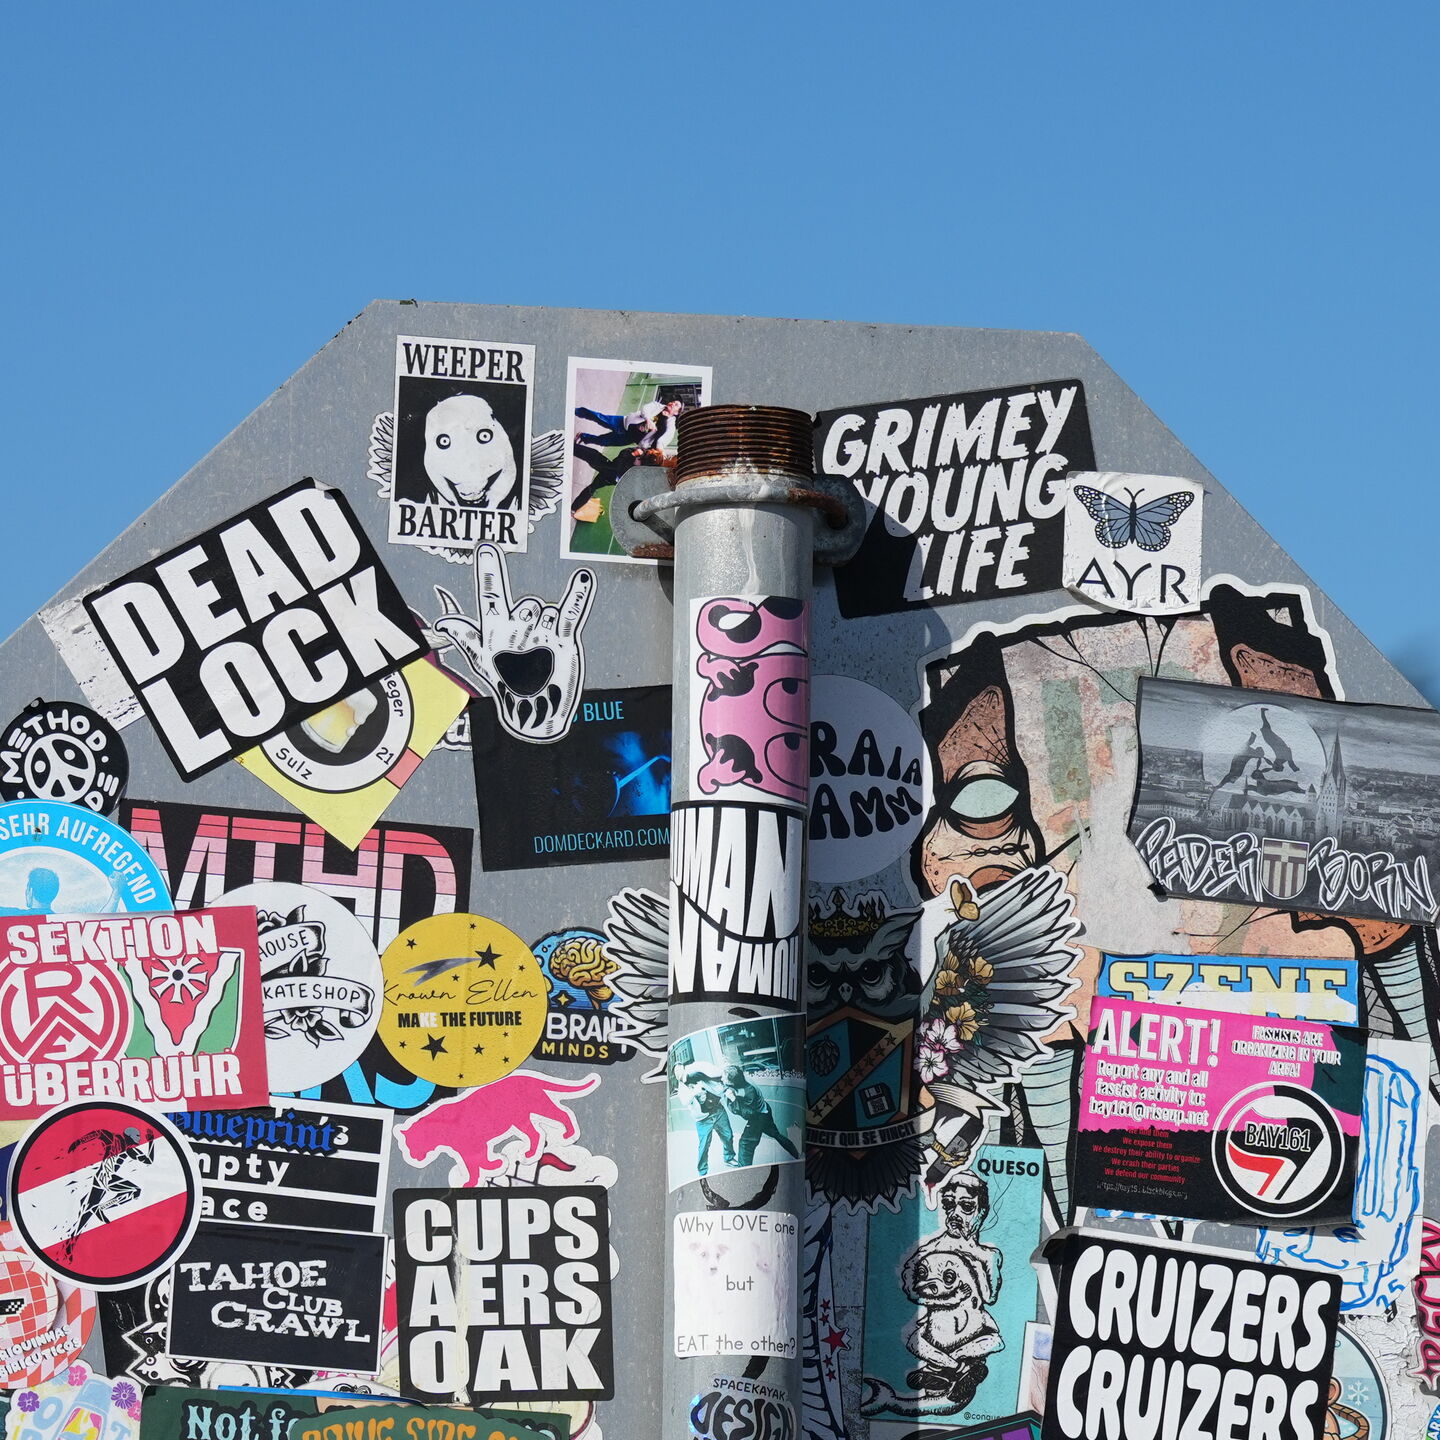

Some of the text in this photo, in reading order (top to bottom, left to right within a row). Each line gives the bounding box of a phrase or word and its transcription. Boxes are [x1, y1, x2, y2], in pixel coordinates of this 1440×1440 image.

[402, 341, 526, 383] WEEPER
[822, 385, 1078, 477] GRIMEY
[851, 452, 1070, 539] YOUNG
[398, 503, 518, 546] BARTER
[903, 522, 1035, 602] LIFE
[1075, 556, 1190, 605] AYR
[90, 487, 362, 685] DEAD
[141, 565, 421, 774] LOCK
[582, 701, 625, 723] BLUE
[0, 709, 107, 783] METHOD
[275, 748, 313, 781] Sulz
[375, 746, 395, 766] 21
[533, 826, 671, 855] DOMDECKARD.COM
[56, 815, 158, 905] AUFREGEND
[670, 806, 804, 939] UMAN
[5, 914, 220, 966] SEKTION
[397, 1010, 523, 1029] MAKE THE FUTURE
[1092, 1008, 1222, 1068] ALERT!
[1252, 1025, 1325, 1048] FASCISTS ARE
[541, 1040, 610, 1060] MINDS
[1311, 1048, 1342, 1066] YOUR
[3, 1052, 243, 1109] ÜBERRUHR
[1096, 1059, 1209, 1088] Report any and all
[862, 1131, 878, 1145] SE
[1244, 1122, 1312, 1153] BAY161
[196, 1150, 291, 1188] mpty
[976, 1156, 1040, 1178] QUESO
[200, 1194, 269, 1222] ace
[678, 1215, 796, 1237] Why LOVE one
[404, 1196, 600, 1263] CUPS
[180, 1259, 328, 1293] TAHOE
[409, 1261, 603, 1328] AERS
[725, 1274, 755, 1292] but
[262, 1287, 345, 1319] CLUB
[1068, 1245, 1332, 1372] CRUIZERS
[210, 1301, 371, 1344] CRAWL
[409, 1328, 606, 1396] OAK
[677, 1334, 798, 1353] EAT the other?
[712, 1378, 786, 1403] SPACEKAYAK
